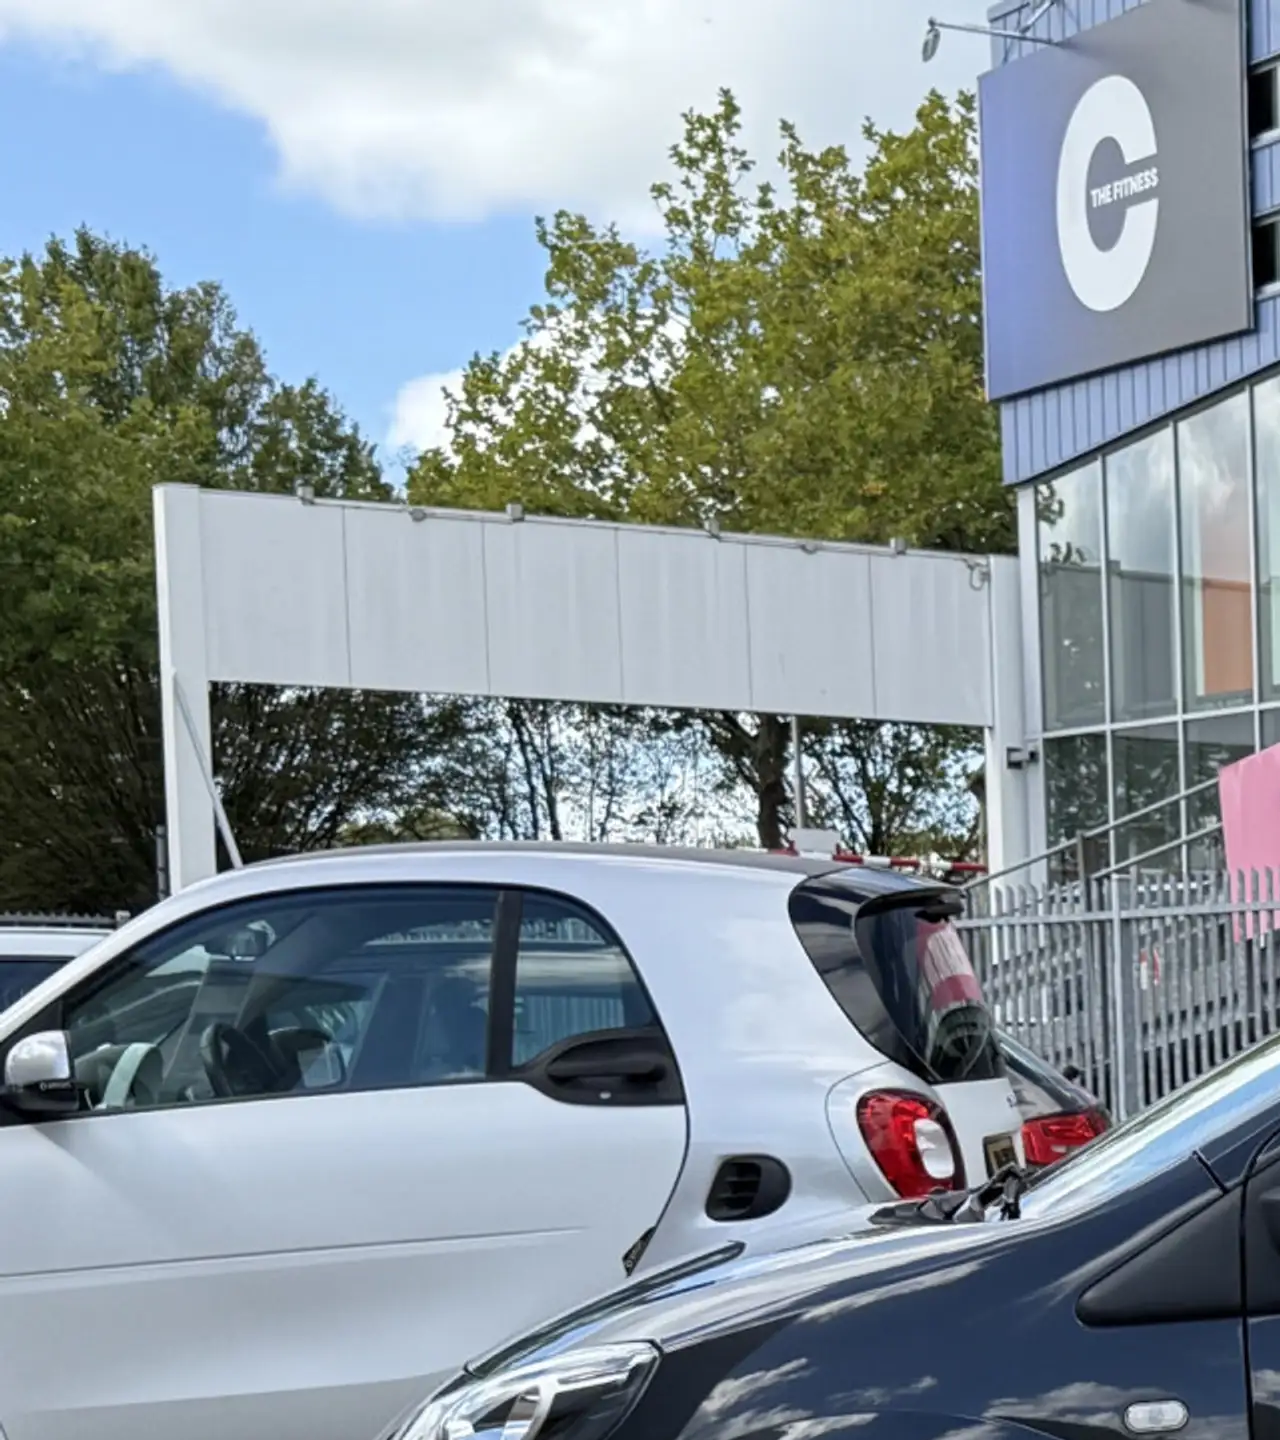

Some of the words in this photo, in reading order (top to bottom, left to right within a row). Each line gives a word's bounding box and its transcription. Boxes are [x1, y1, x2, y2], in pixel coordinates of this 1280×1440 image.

[1057, 75, 1159, 312] C
[1091, 183, 1113, 208] THE
[1113, 167, 1160, 201] FITNESS
